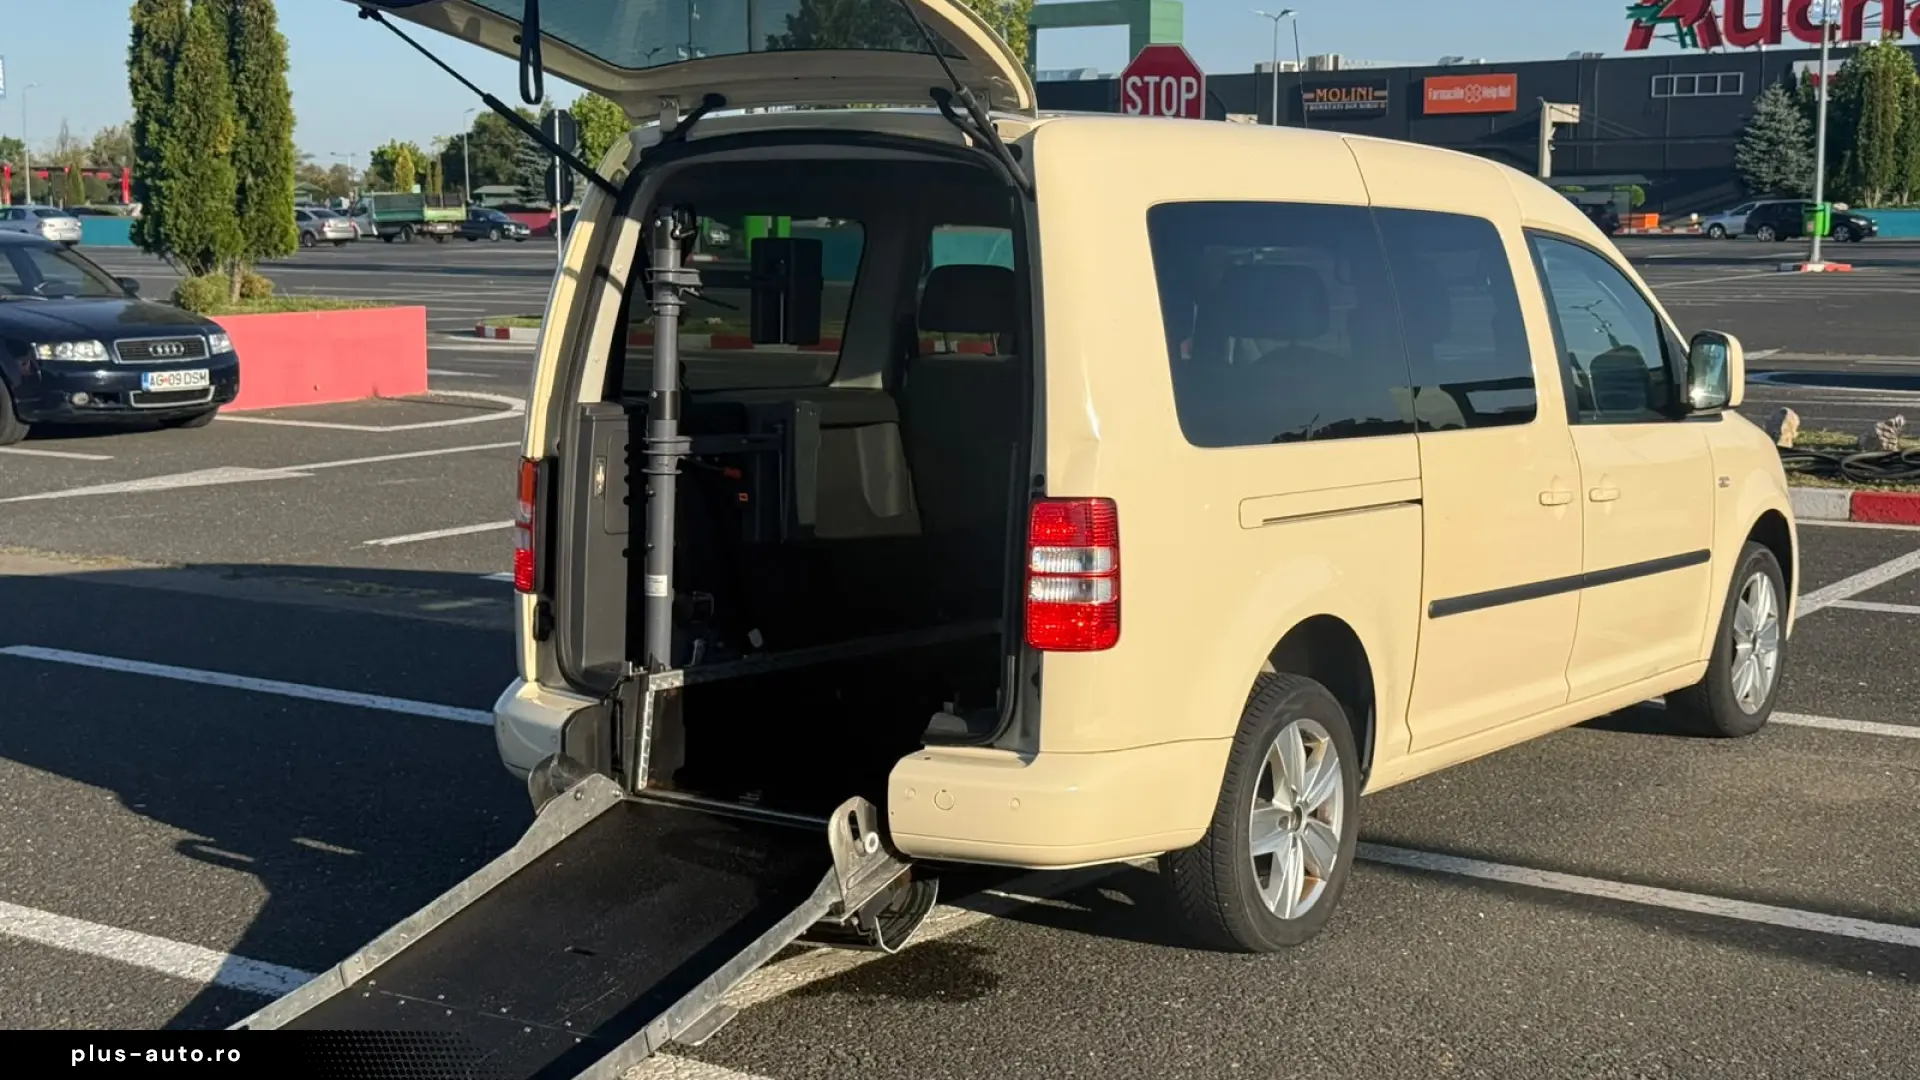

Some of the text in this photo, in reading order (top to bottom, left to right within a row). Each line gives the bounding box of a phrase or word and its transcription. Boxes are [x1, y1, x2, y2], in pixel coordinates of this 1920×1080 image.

[1126, 76, 1199, 117] STOP
[1315, 87, 1373, 102] MOLINI
[149, 374, 164, 386] AG
[168, 373, 182, 386] 09
